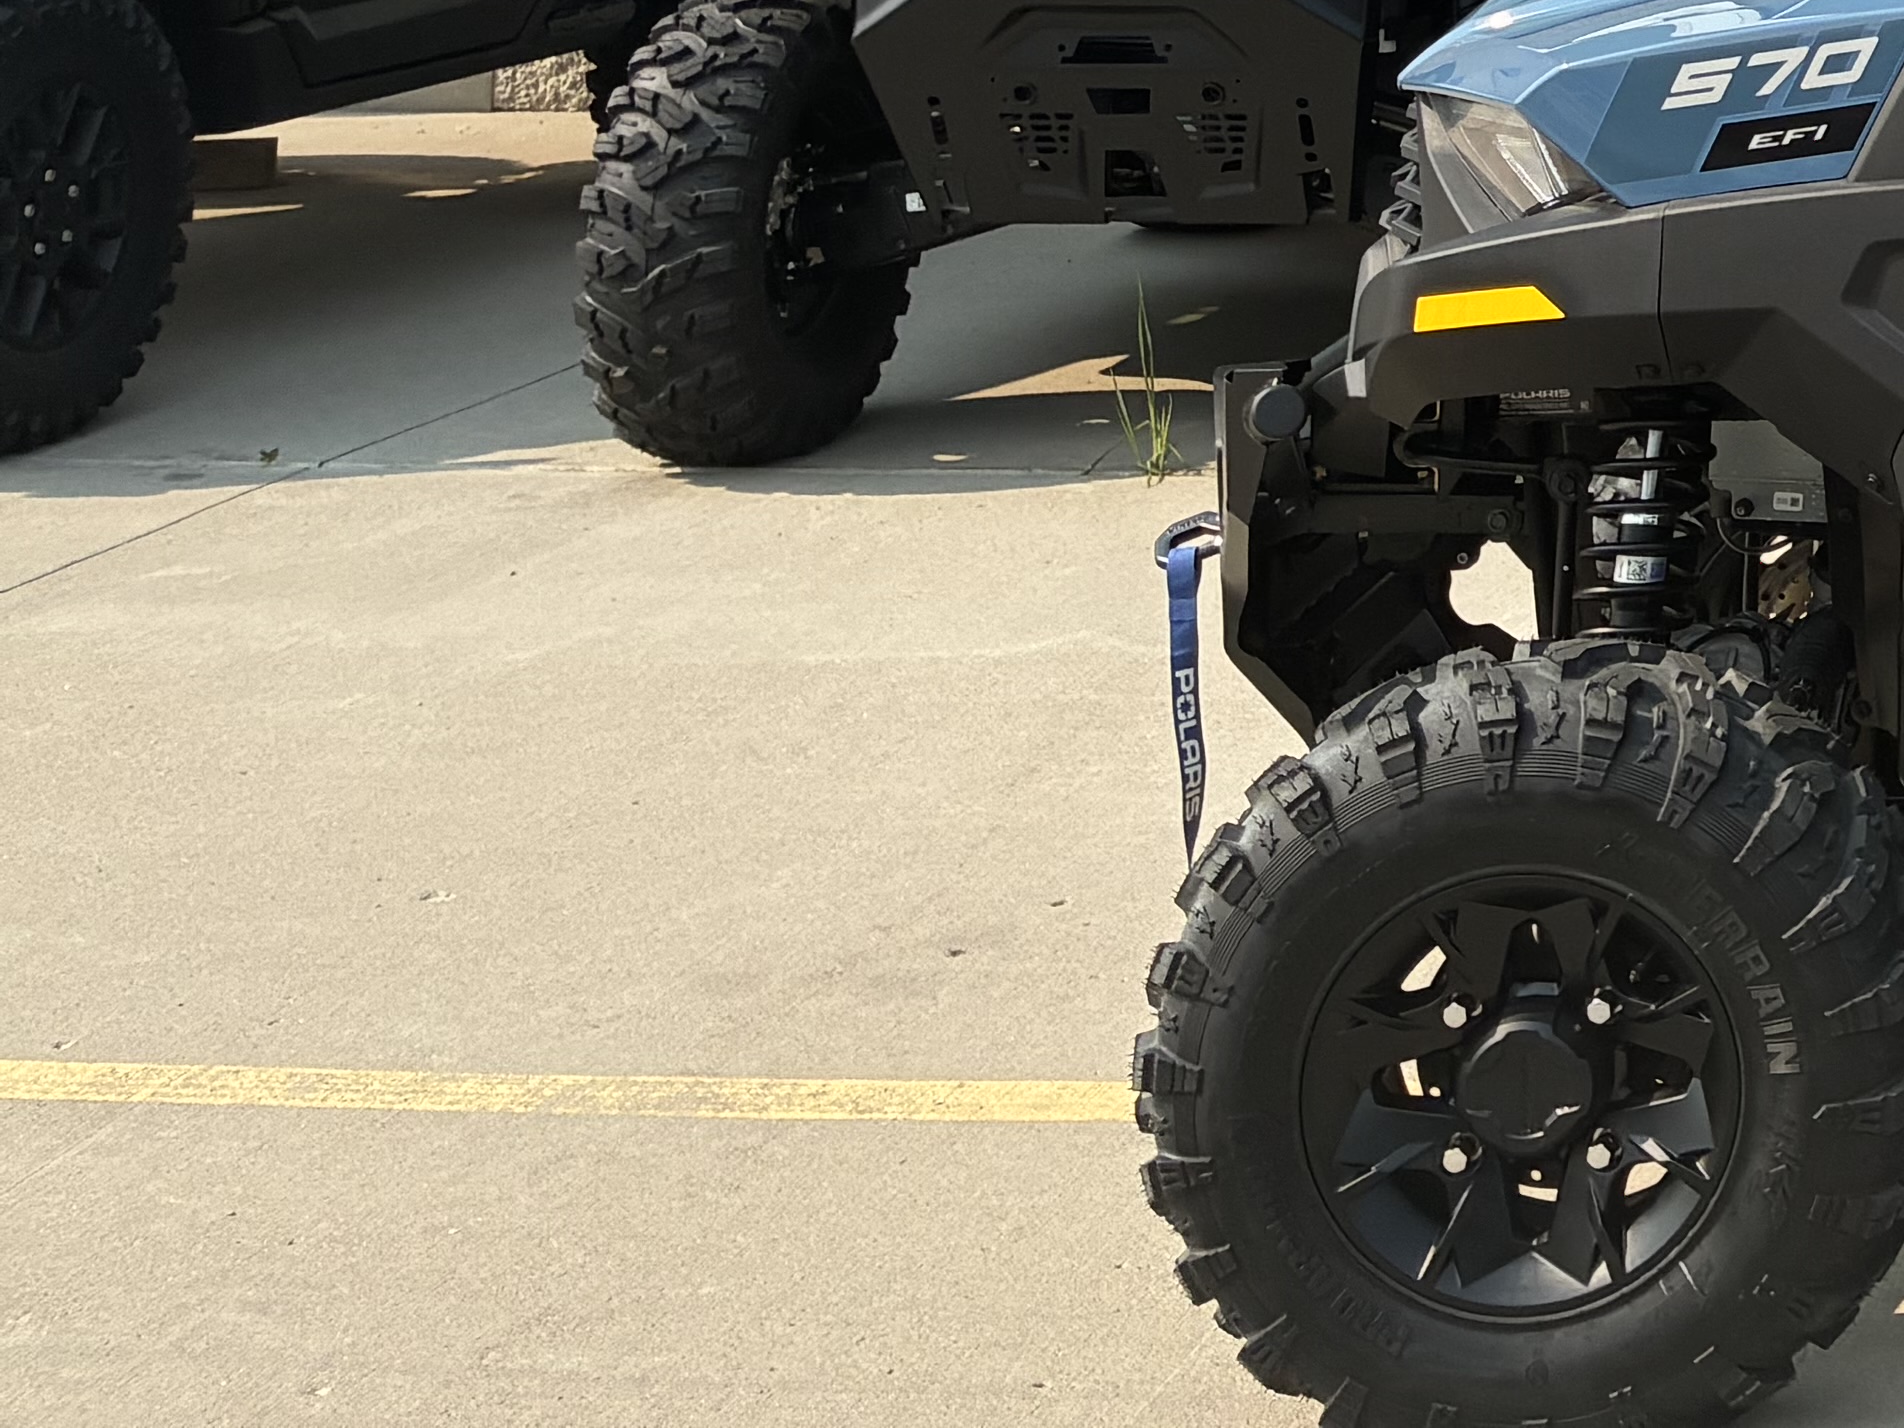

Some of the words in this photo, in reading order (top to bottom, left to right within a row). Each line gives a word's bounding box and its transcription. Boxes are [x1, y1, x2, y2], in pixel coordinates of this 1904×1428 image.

[1661, 36, 1879, 110] 570
[1748, 124, 1828, 150] EFI
[1174, 667, 1203, 822] POLARIS
